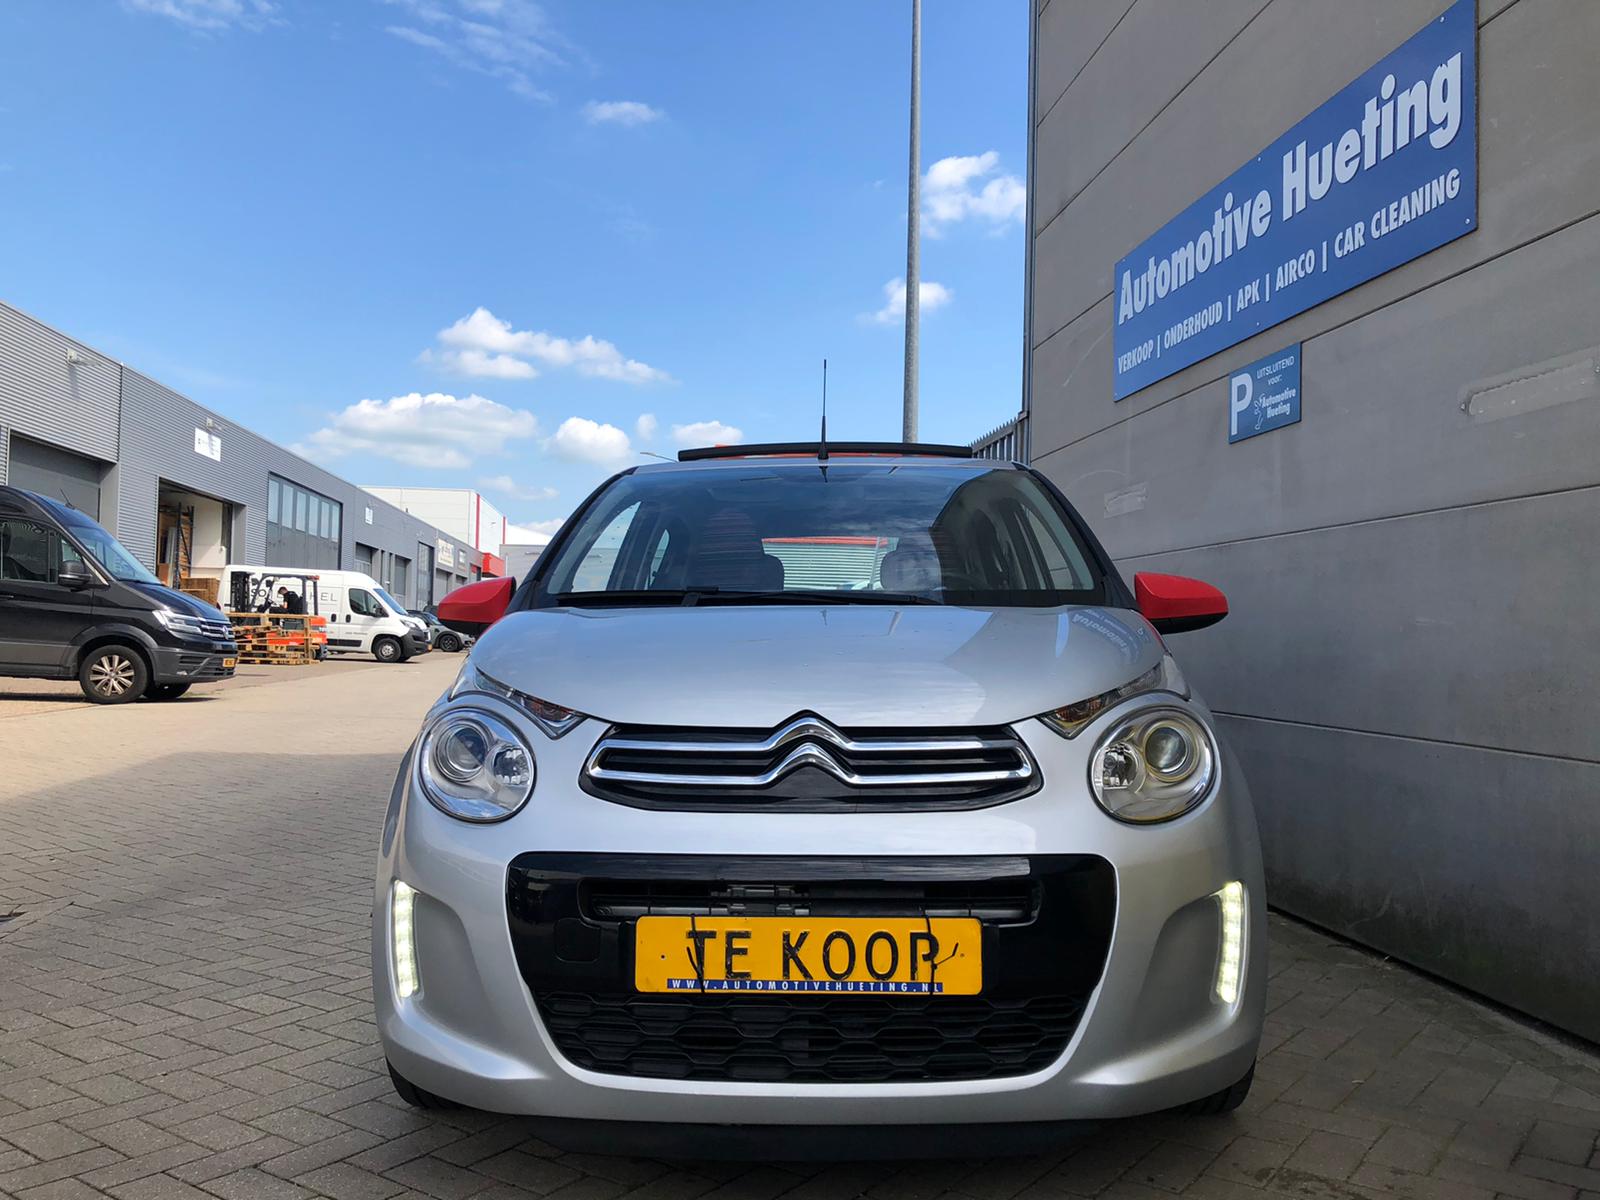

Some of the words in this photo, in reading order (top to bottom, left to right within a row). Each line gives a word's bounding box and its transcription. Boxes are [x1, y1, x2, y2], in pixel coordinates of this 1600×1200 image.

[1118, 191, 1272, 325] Automotive
[1282, 52, 1463, 221] Hueting
[1117, 339, 1154, 374] VERKOOP
[1164, 301, 1223, 349] ONDERHOUD
[1236, 278, 1261, 312] APK
[1275, 249, 1315, 292] AIRCO
[1334, 221, 1365, 258] CAR
[1370, 168, 1460, 239] CLEANING
[1256, 356, 1295, 379] UITSLUITEND
[1231, 373, 1253, 436] P
[1261, 387, 1297, 409] Automotive
[686, 930, 752, 979] TE
[782, 930, 939, 981] KOOP
[672, 979, 939, 992] WWW.AUTOMOTIVEHUETING.NL
